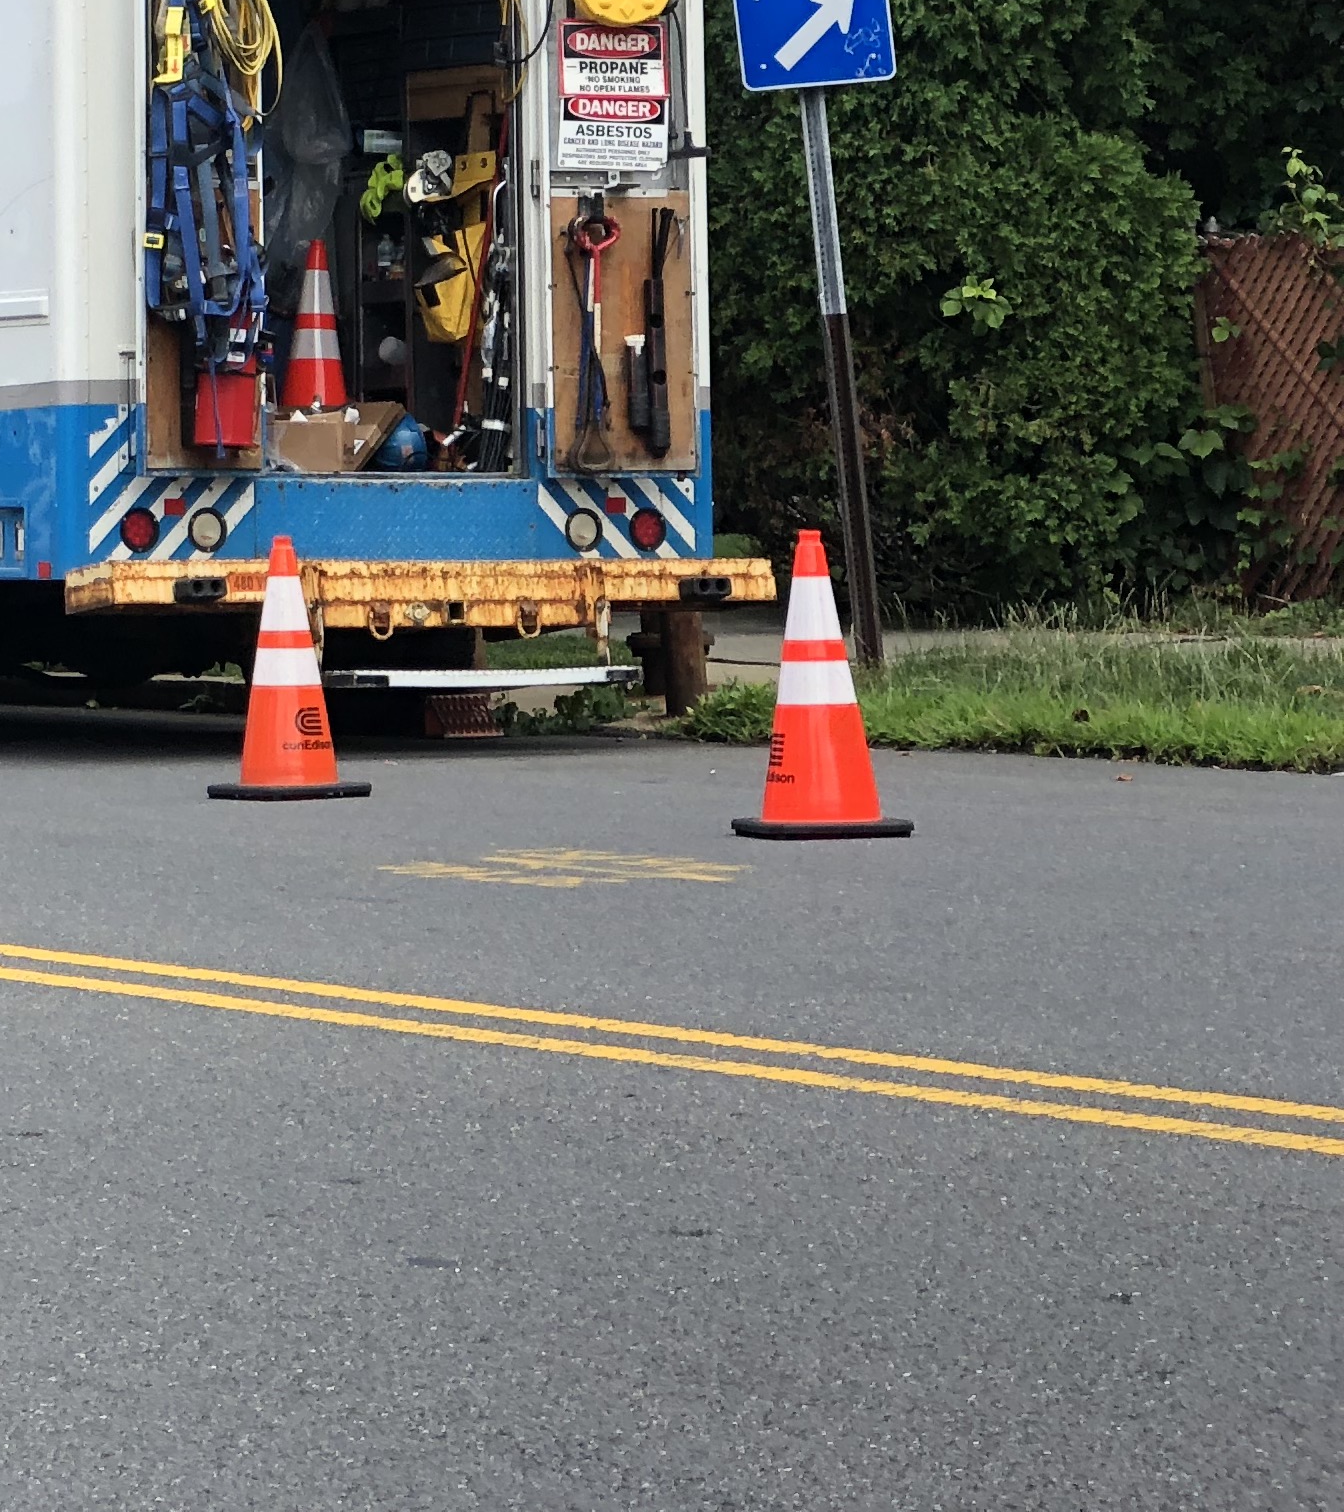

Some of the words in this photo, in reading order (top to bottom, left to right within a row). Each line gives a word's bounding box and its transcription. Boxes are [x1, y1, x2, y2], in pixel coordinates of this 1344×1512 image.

[575, 33, 650, 52] DANGER
[579, 61, 649, 75] PROPANE
[619, 85, 650, 93] FLAMES
[578, 99, 651, 117] DANGER
[575, 124, 653, 139] ASBESTOS
